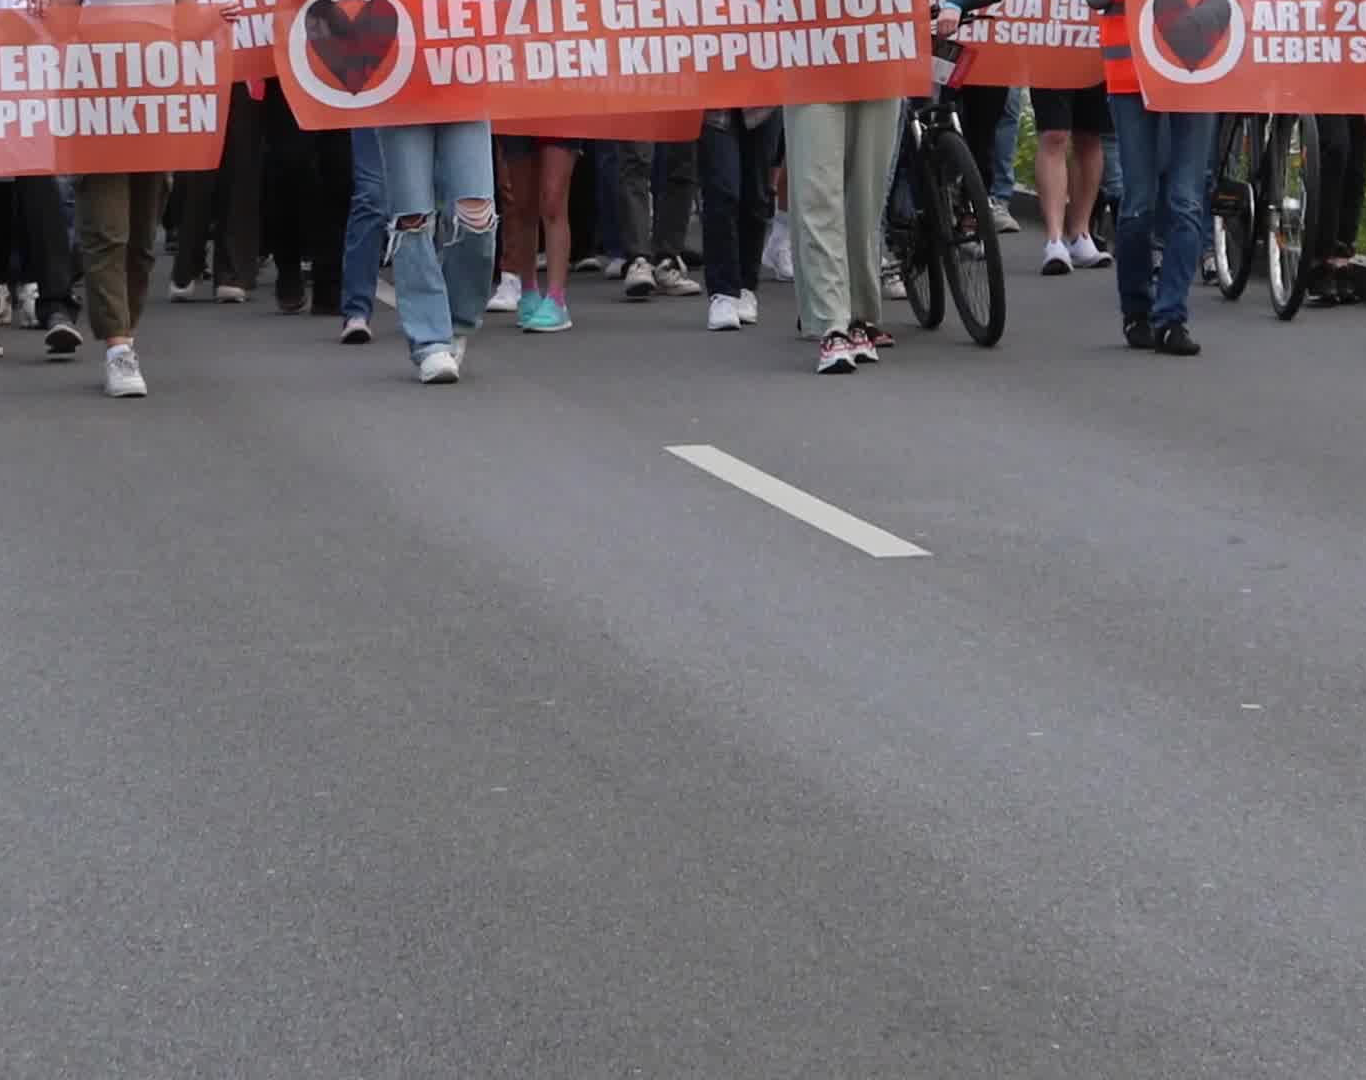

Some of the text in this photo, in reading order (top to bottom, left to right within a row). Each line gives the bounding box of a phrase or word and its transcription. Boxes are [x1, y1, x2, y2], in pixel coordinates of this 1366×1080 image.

[1251, 0, 1327, 32] ART.
[425, 44, 515, 85] VOR
[525, 38, 608, 80] DEN
[619, 21, 916, 75] KIPPPUNKTEN
[1252, 36, 1341, 63] LEBEN
